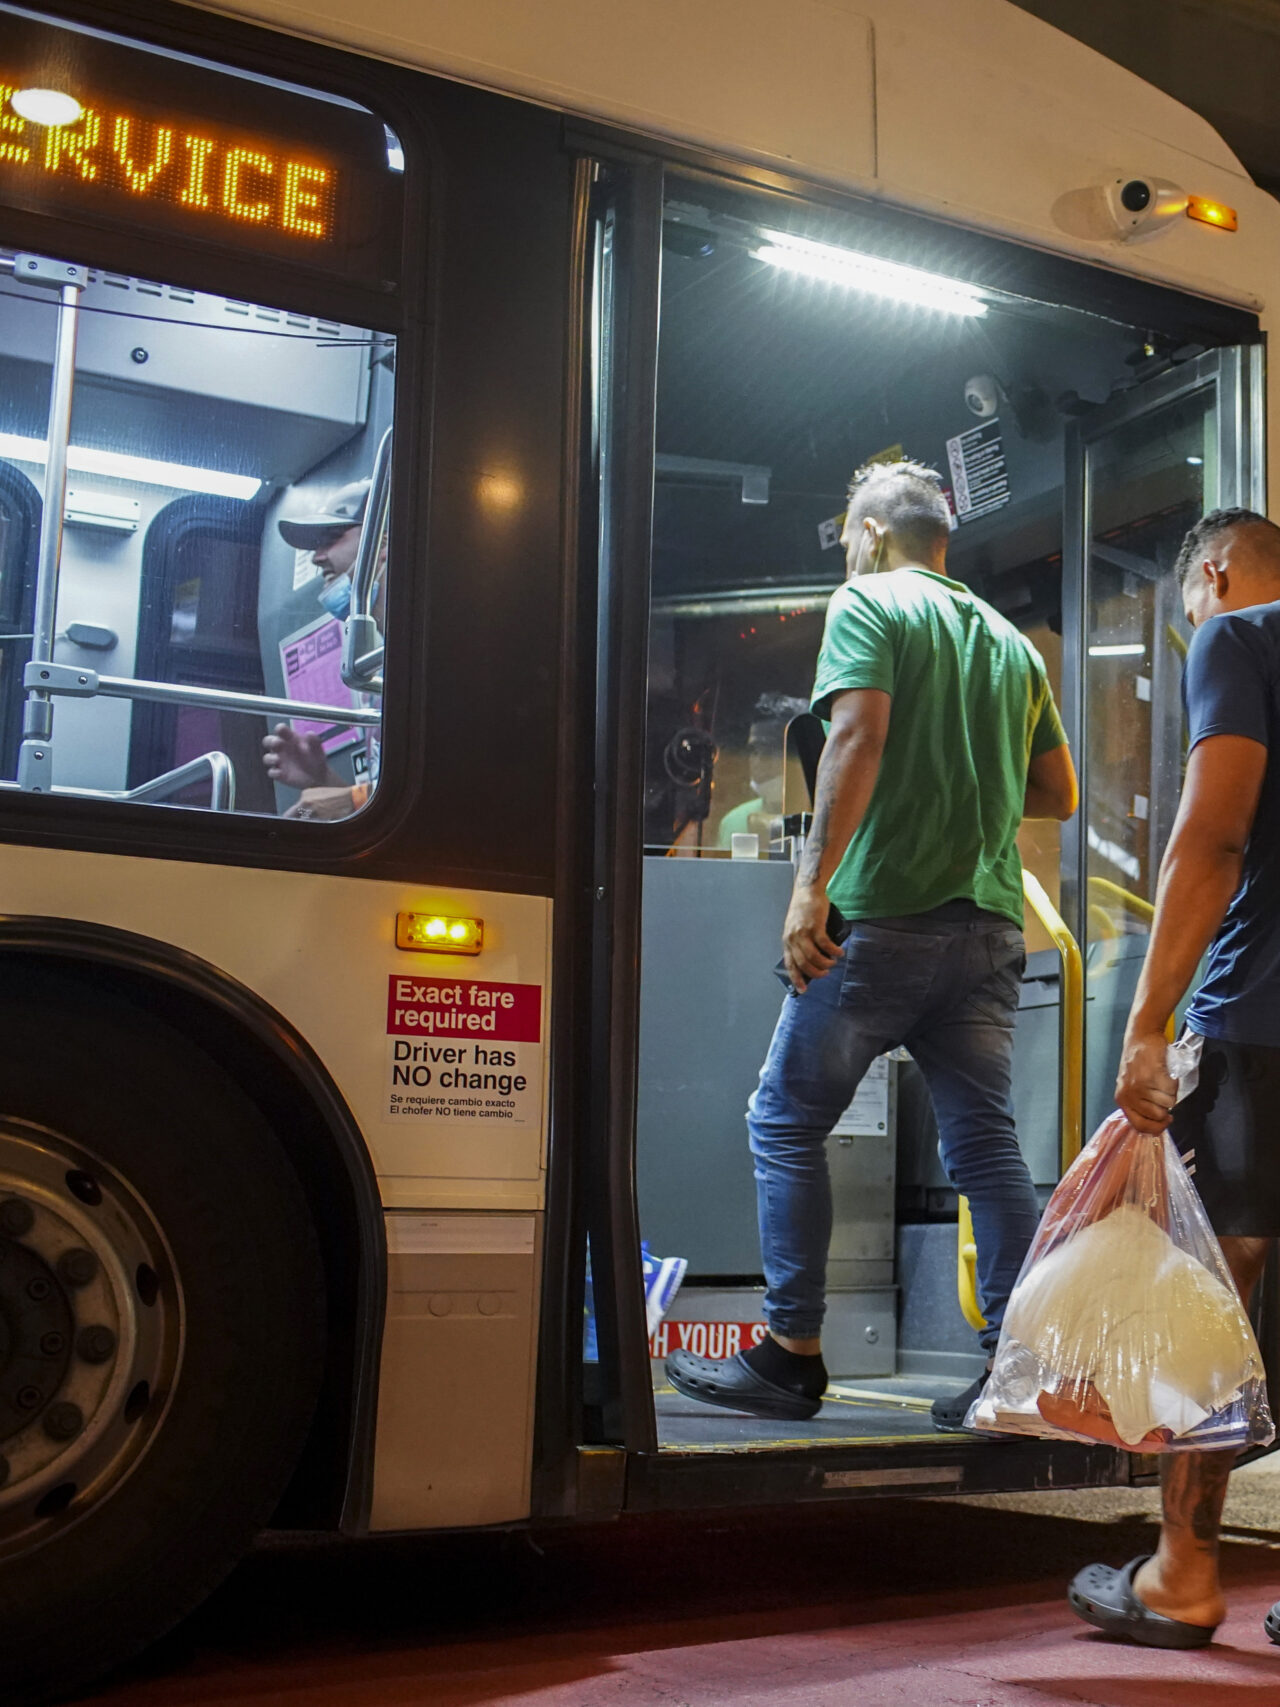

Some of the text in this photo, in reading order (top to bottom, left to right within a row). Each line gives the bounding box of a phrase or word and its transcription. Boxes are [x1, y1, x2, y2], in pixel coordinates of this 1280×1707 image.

[396, 980, 515, 1009] Exact fare
[394, 1008, 496, 1033] required
[394, 1040, 517, 1067] Driver has
[392, 1065, 527, 1096] NO change
[389, 1105, 513, 1119] El chofer NO tiene cambio
[390, 1094, 516, 1108] Se requiere cambio exacto
[649, 1323, 770, 1359] H YOUR S
